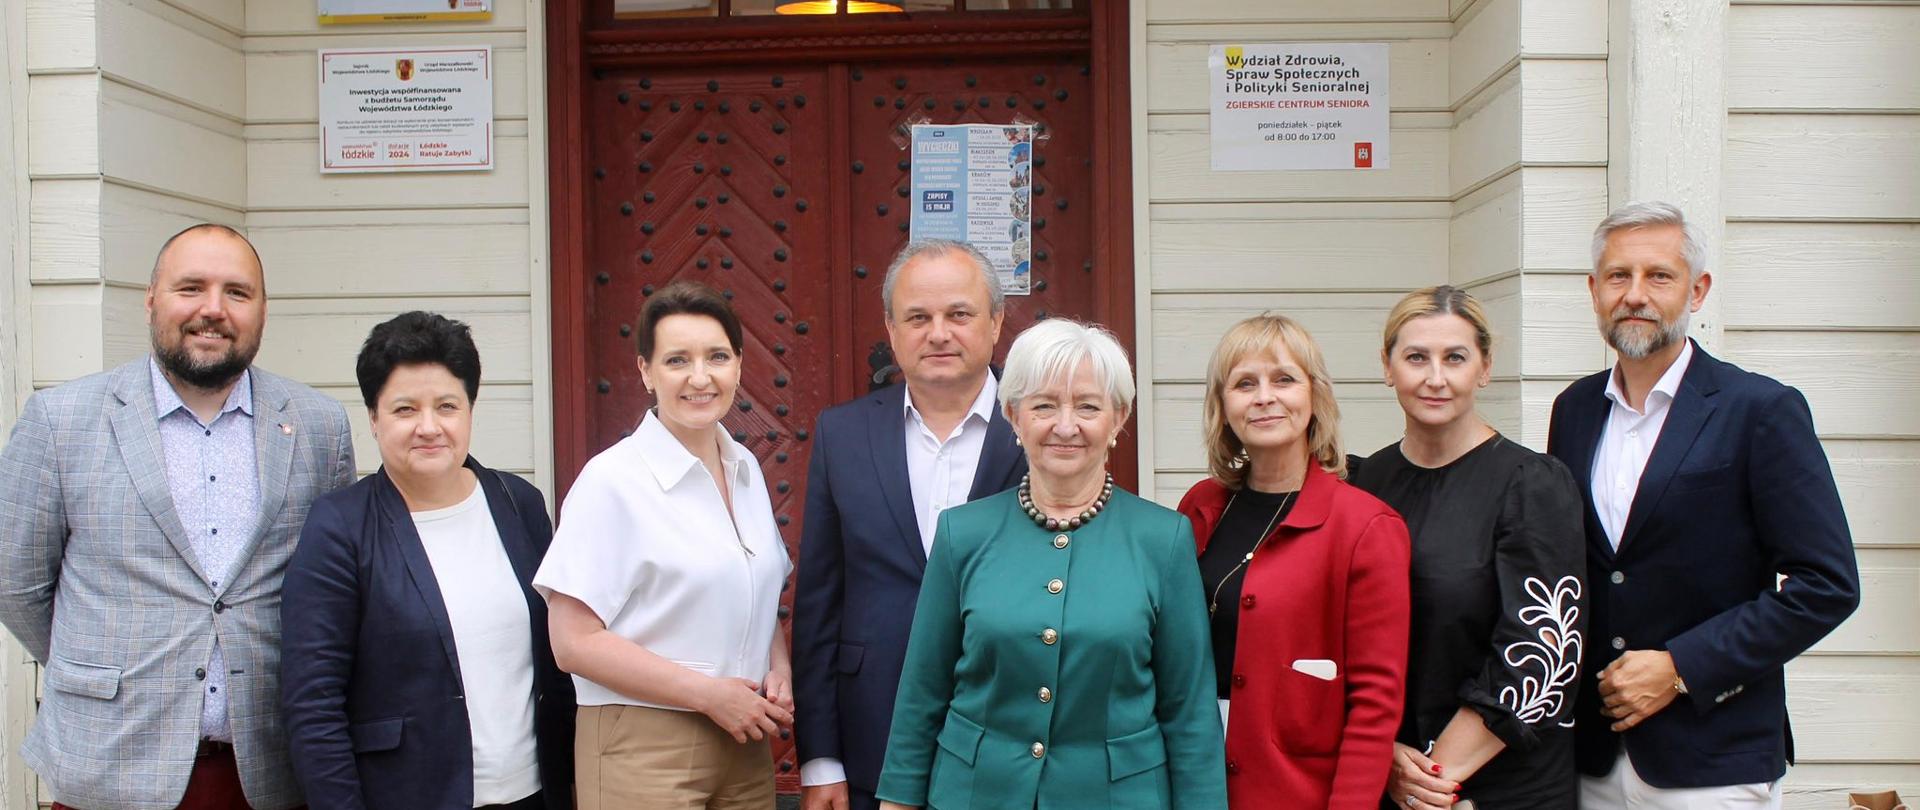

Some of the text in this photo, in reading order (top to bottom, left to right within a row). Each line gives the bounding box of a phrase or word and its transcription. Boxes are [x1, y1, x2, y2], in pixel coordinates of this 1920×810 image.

[1226, 55, 1345, 69] Wydział Zdrowia,
[1226, 68, 1360, 82] Spraw Społecznych
[391, 87, 461, 95] współfinansowana
[1226, 81, 1370, 95] i Polityki Senioralnej
[1226, 101, 1275, 109] ZGIERSKIE
[1258, 121, 1308, 130] poniedziałek
[1317, 121, 1342, 130] piątek
